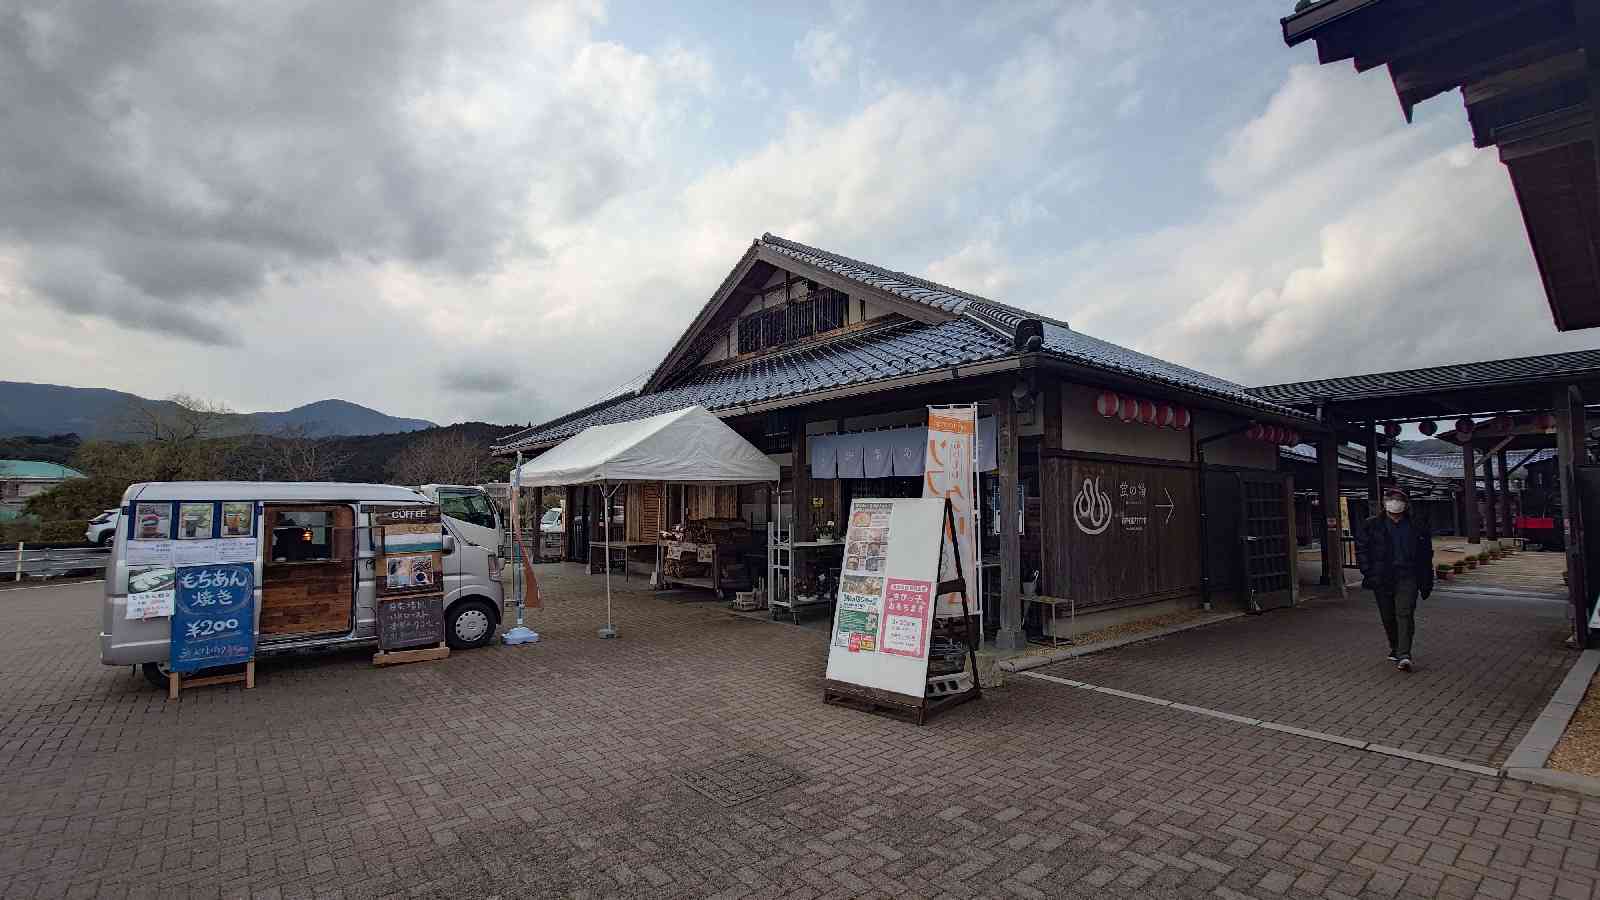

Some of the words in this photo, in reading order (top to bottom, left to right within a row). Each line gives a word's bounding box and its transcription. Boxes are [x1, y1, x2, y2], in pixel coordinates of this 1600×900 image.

[391, 509, 427, 520] COFFEE
[181, 569, 248, 589] もちあん
[191, 589, 233, 607] 焼き
[184, 618, 239, 638] ¥200
